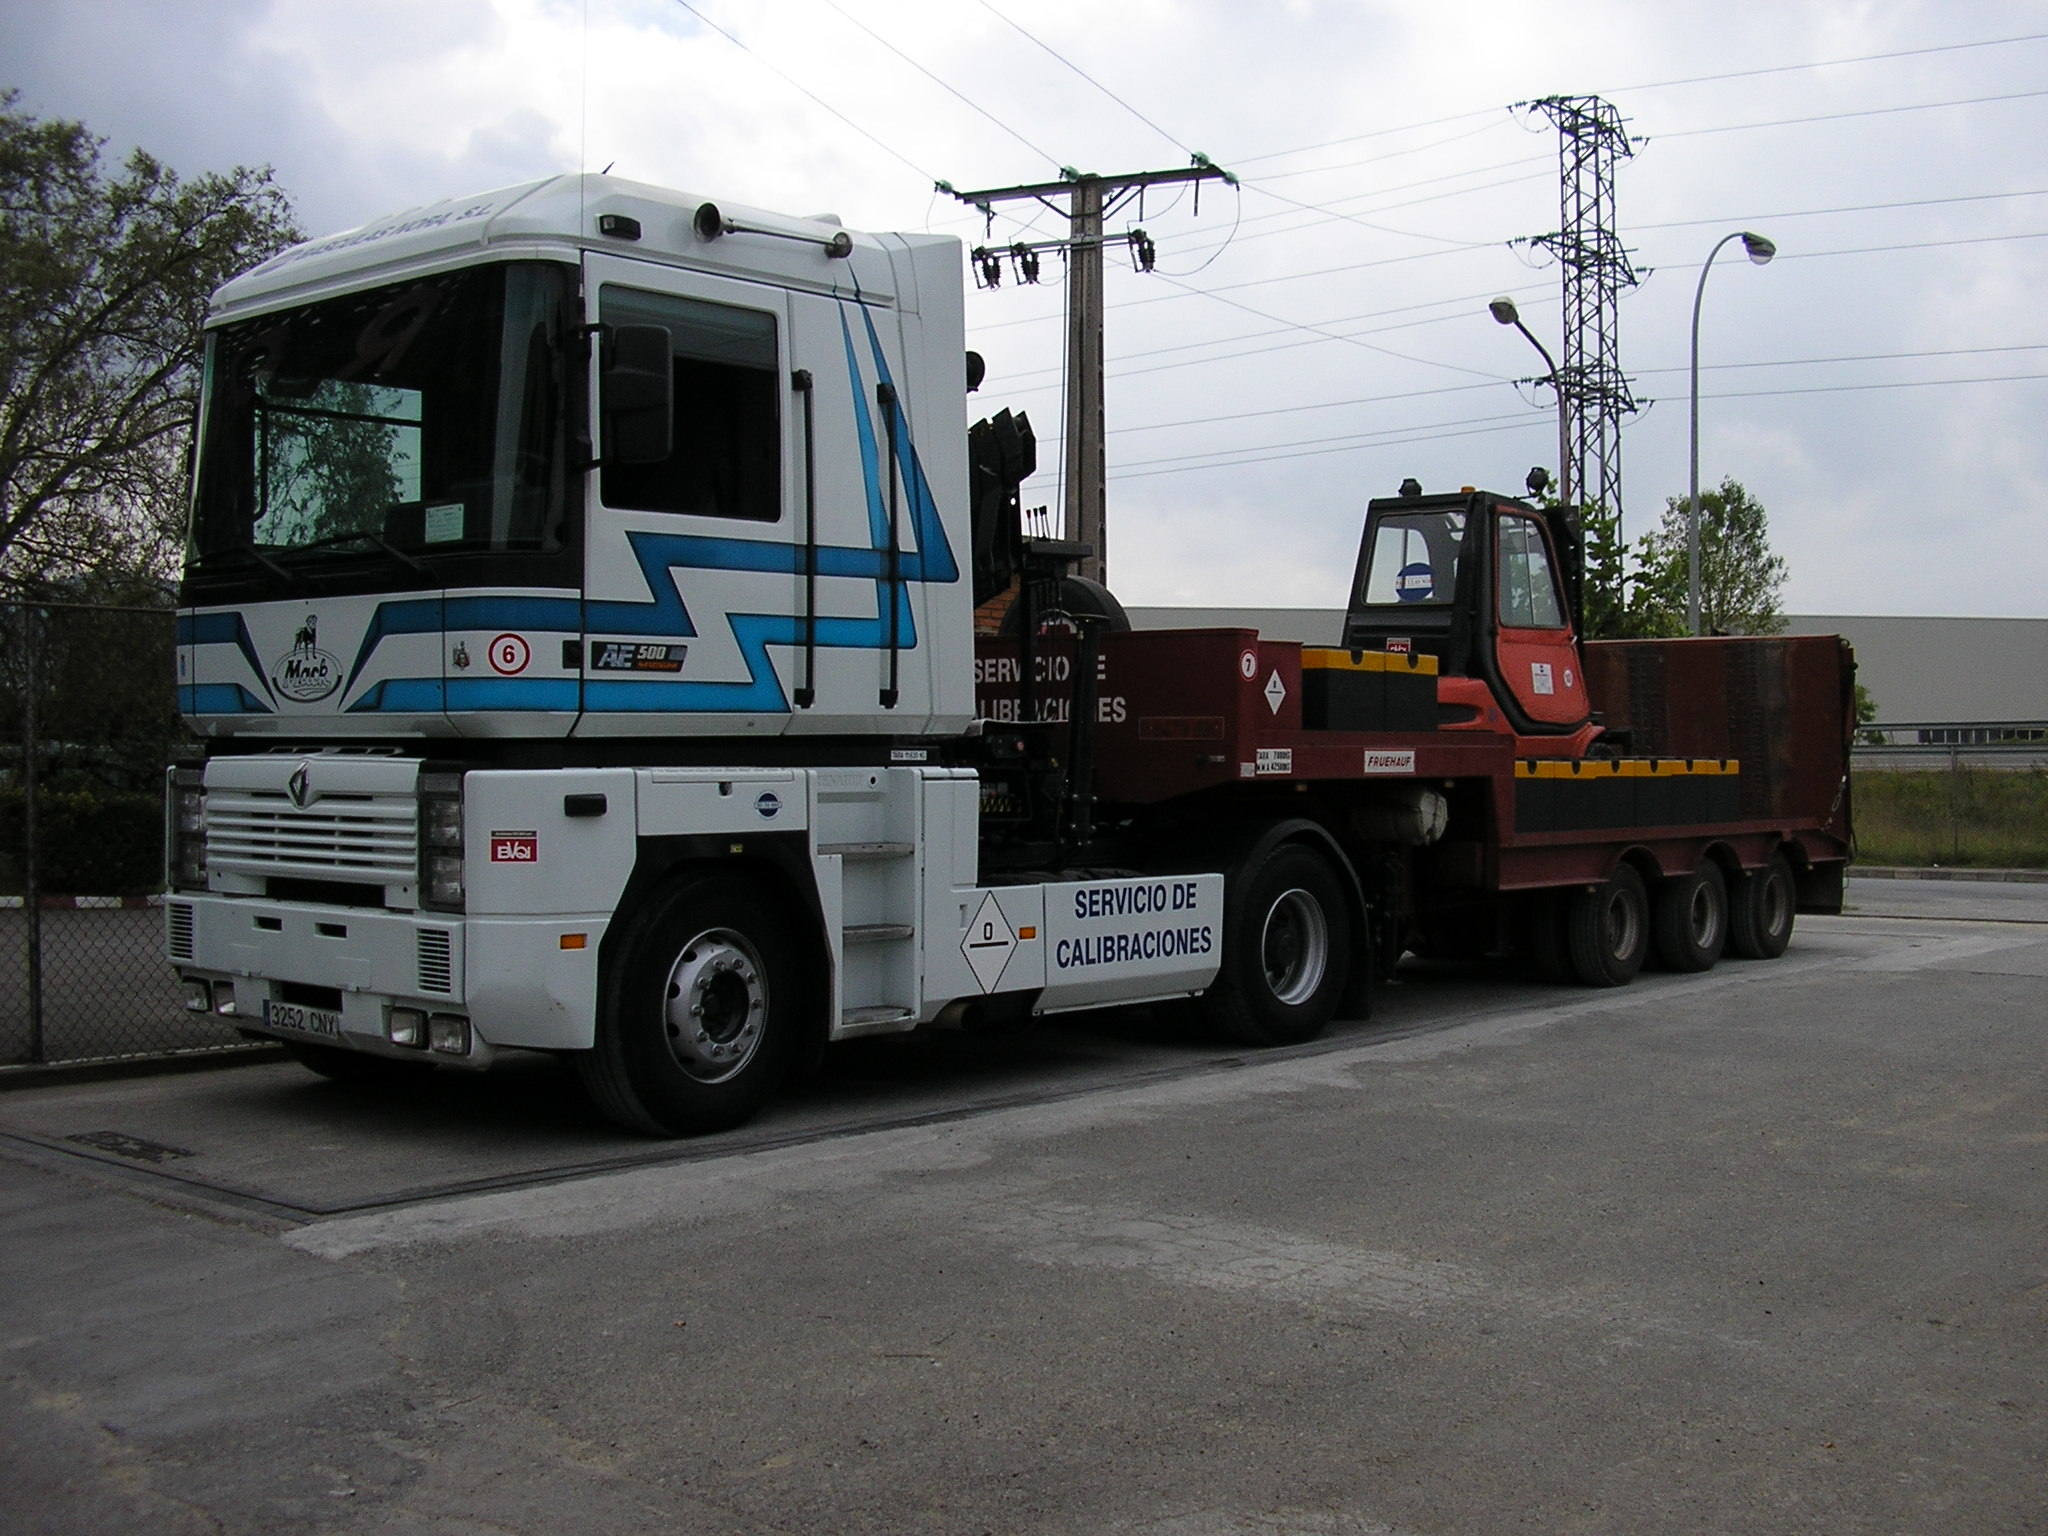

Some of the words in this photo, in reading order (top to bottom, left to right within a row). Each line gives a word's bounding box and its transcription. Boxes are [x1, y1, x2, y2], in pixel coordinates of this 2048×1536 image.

[502, 644, 514, 664] 6
[597, 644, 635, 668] AE
[637, 646, 666, 660] 500
[1245, 658, 1251, 671] 7
[1367, 756, 1411, 767] FRUEHAUF
[1074, 884, 1167, 920] SERVICIO
[1172, 882, 1197, 910] DE
[983, 921, 993, 941] 0
[1056, 926, 1212, 969] CALIBRACIONES
[271, 1004, 306, 1032] 3252
[310, 1011, 335, 1036] CNX
